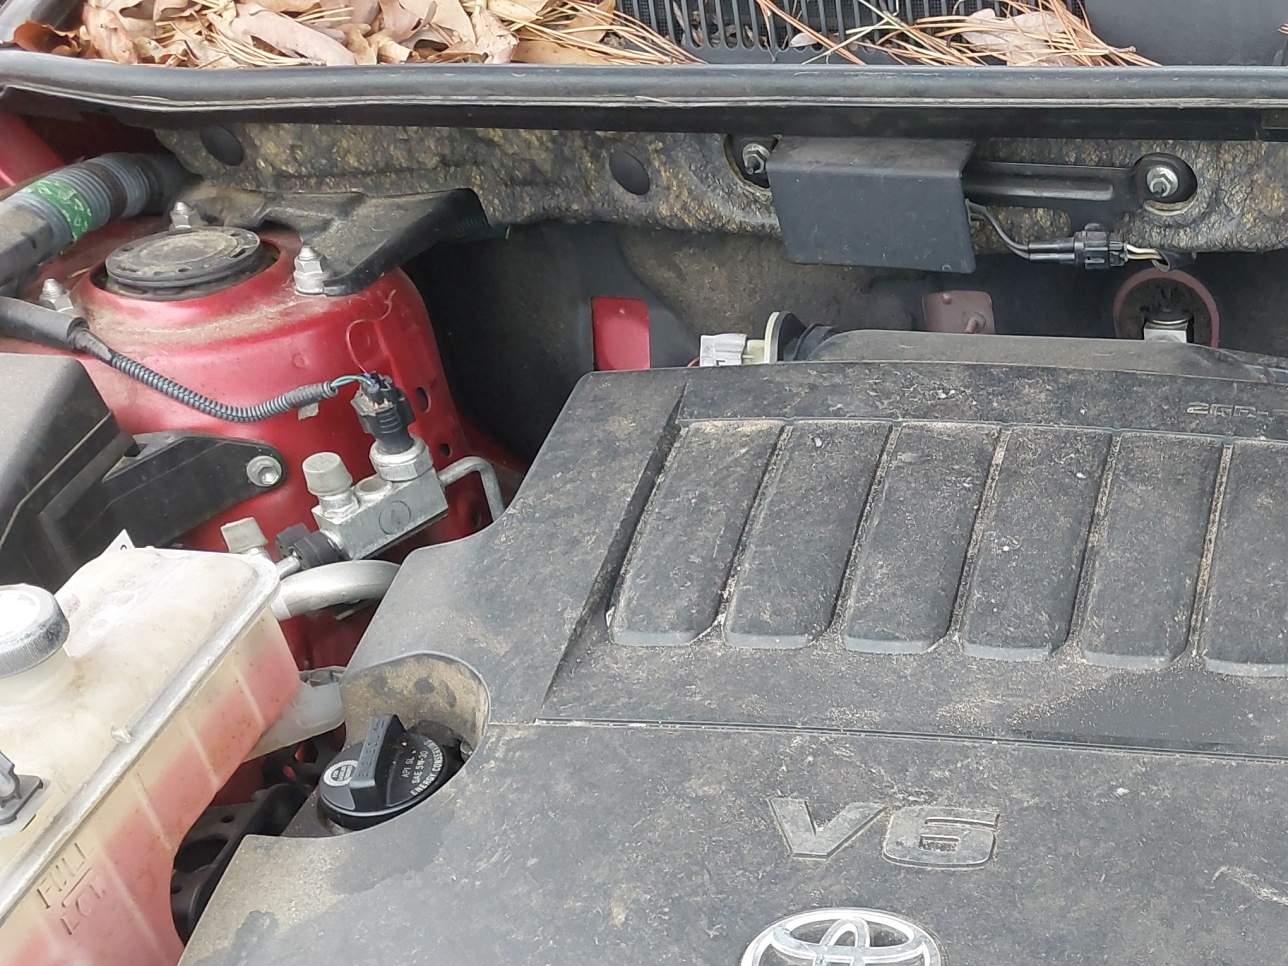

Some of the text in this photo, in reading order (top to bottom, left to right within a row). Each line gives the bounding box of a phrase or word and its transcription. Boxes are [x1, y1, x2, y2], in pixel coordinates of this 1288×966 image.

[410, 774, 435, 796] ENERGY
[412, 769, 422, 784] SAE
[767, 796, 1001, 870] V6
